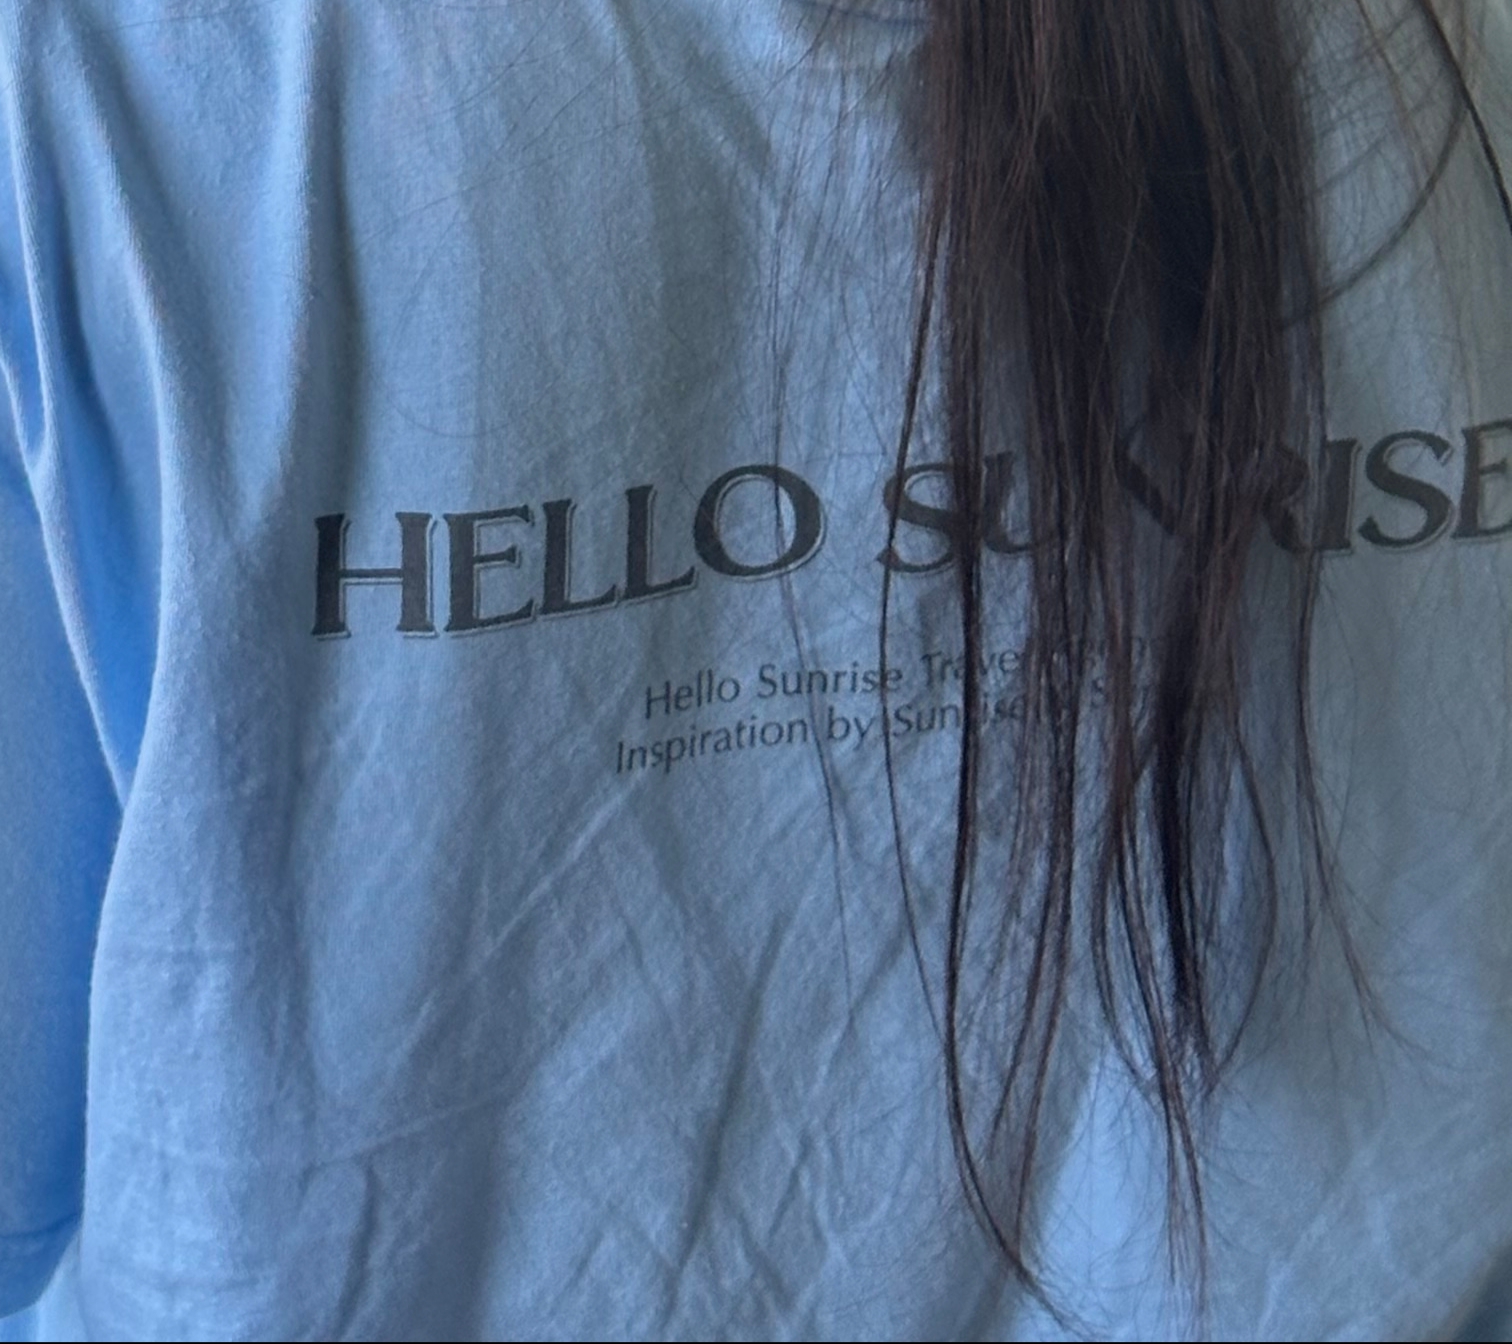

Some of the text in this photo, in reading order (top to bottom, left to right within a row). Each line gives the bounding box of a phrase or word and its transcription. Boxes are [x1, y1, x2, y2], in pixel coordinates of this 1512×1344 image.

[311, 463, 827, 639] HELLO
[644, 648, 1025, 720] Hello Sunrise Trave
[615, 694, 1028, 775] Inspiration by Sunise
